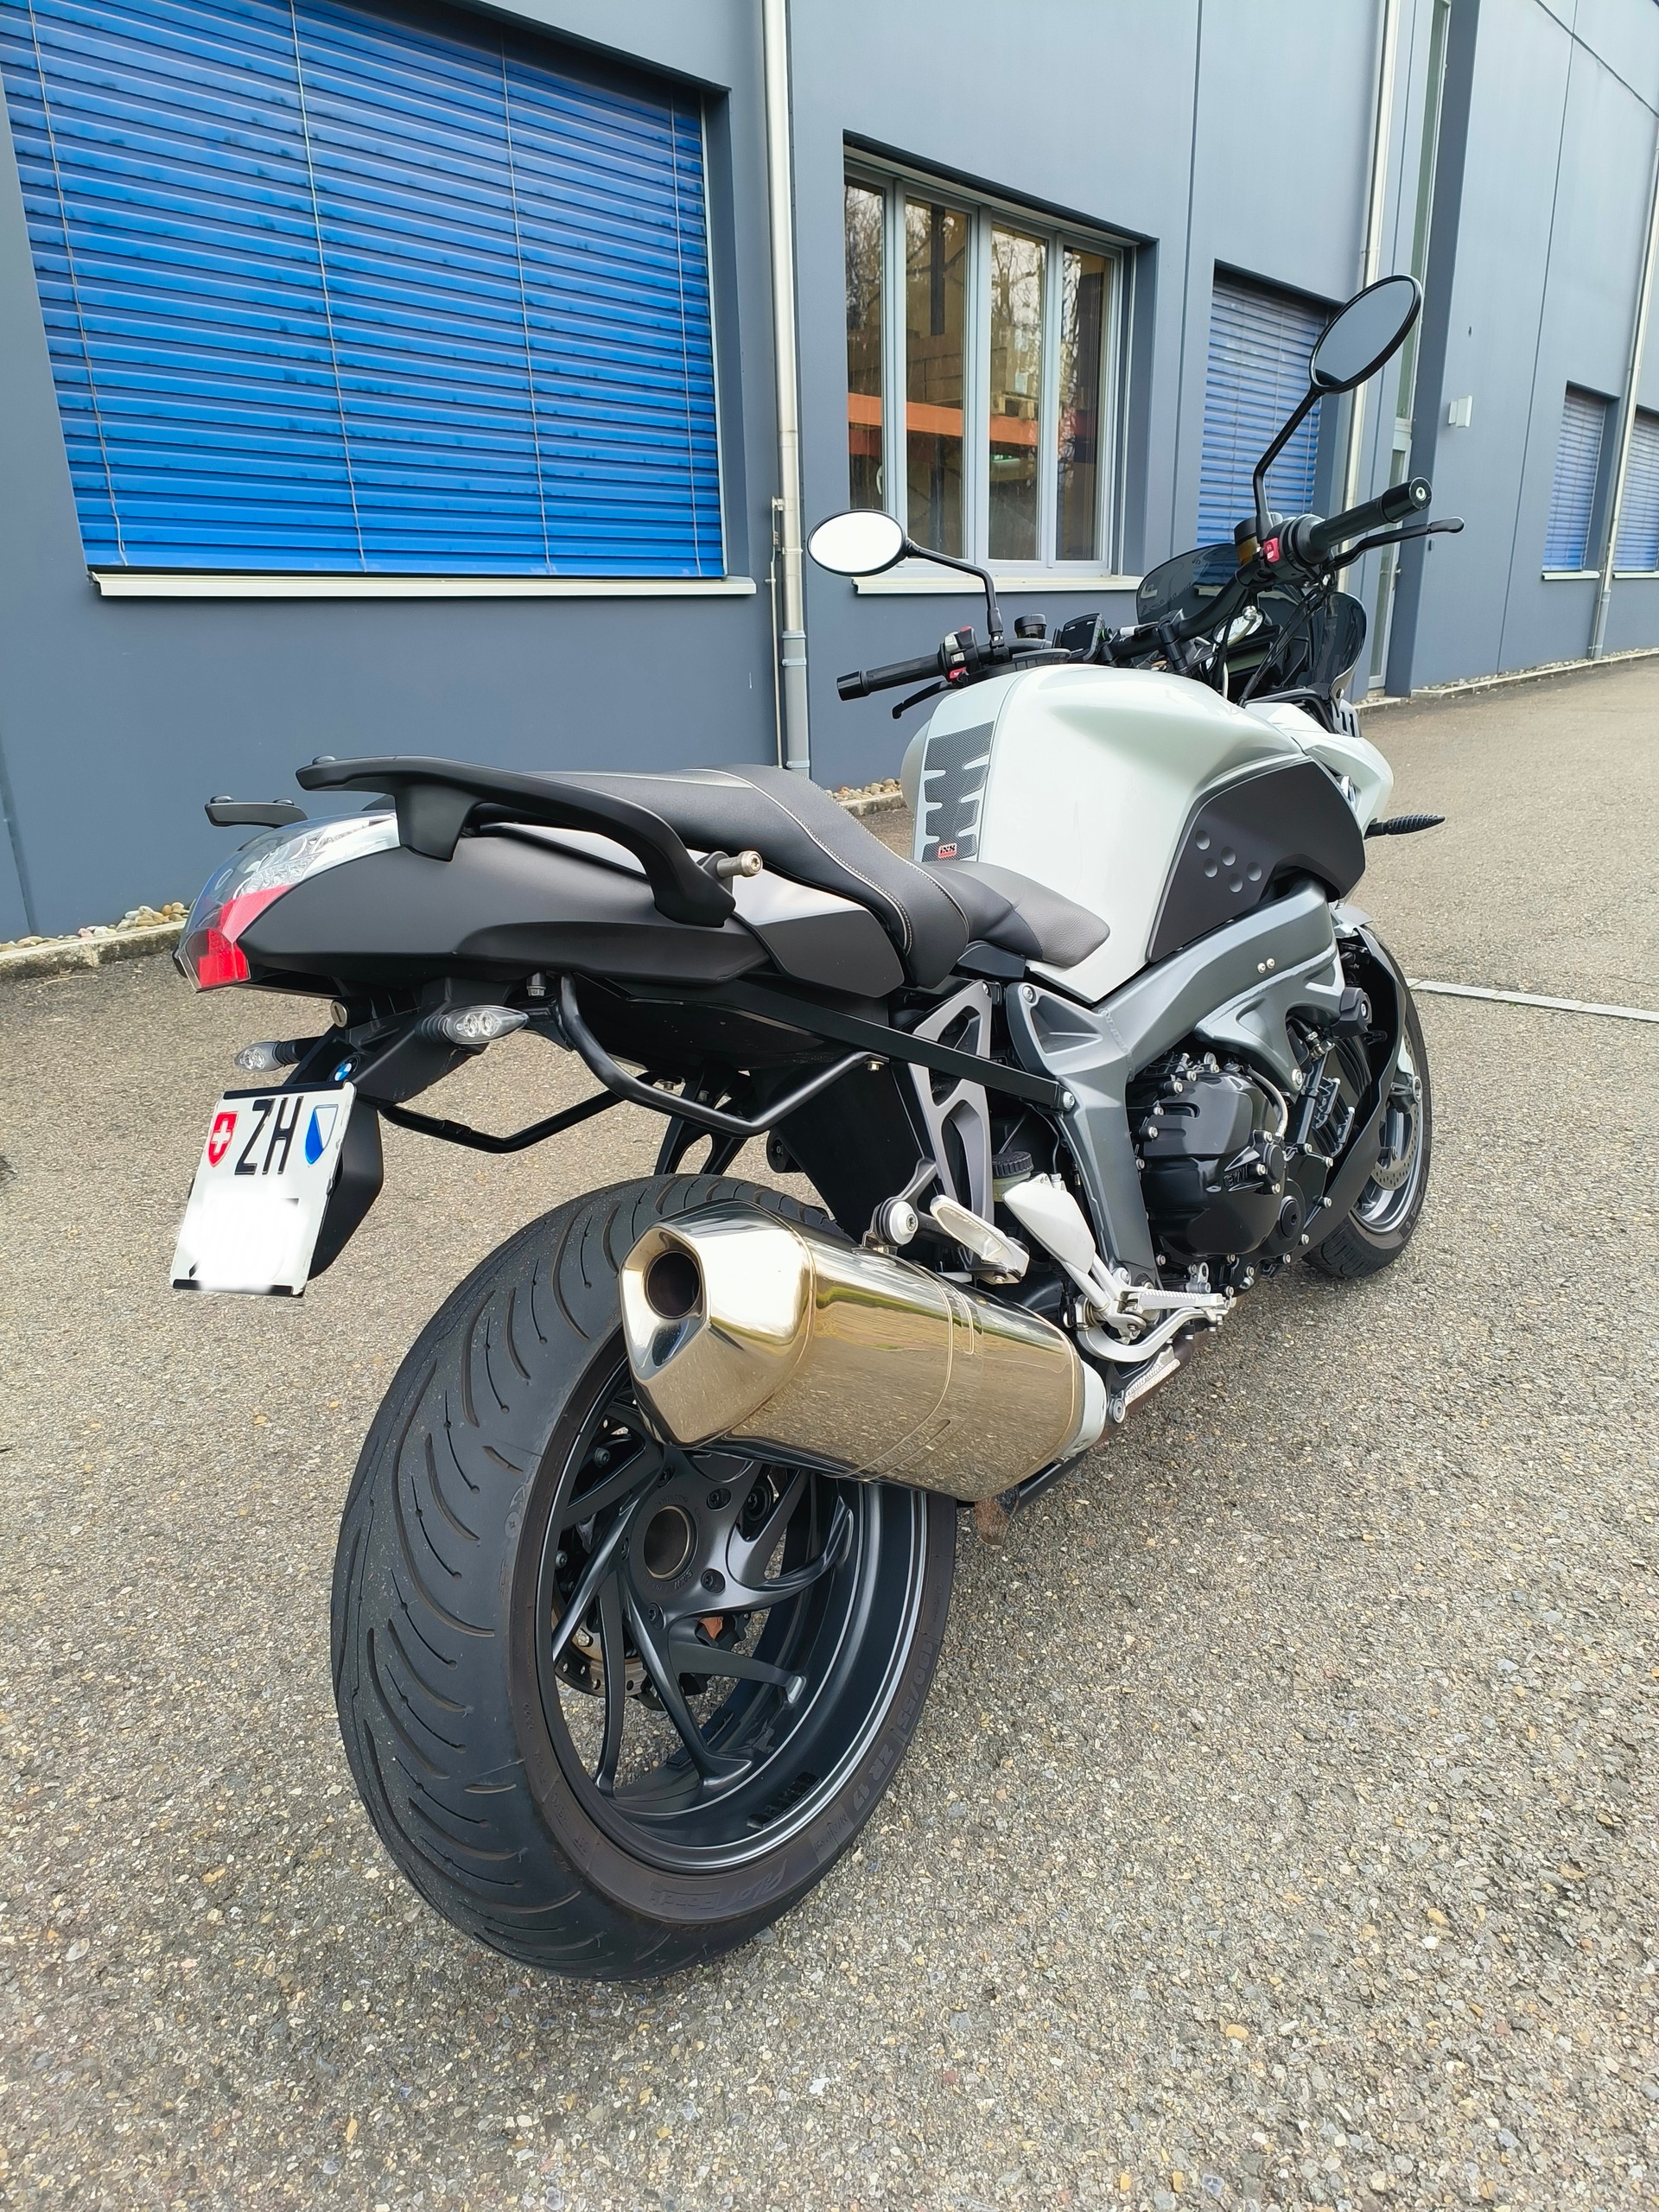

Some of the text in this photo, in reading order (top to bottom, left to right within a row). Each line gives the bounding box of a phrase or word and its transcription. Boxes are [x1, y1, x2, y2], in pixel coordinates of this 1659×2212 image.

[234, 1096, 304, 1175] ZH
[897, 1643, 933, 1729] 190/55
[868, 1744, 894, 1781] ZR
[853, 1783, 871, 1812] 17
